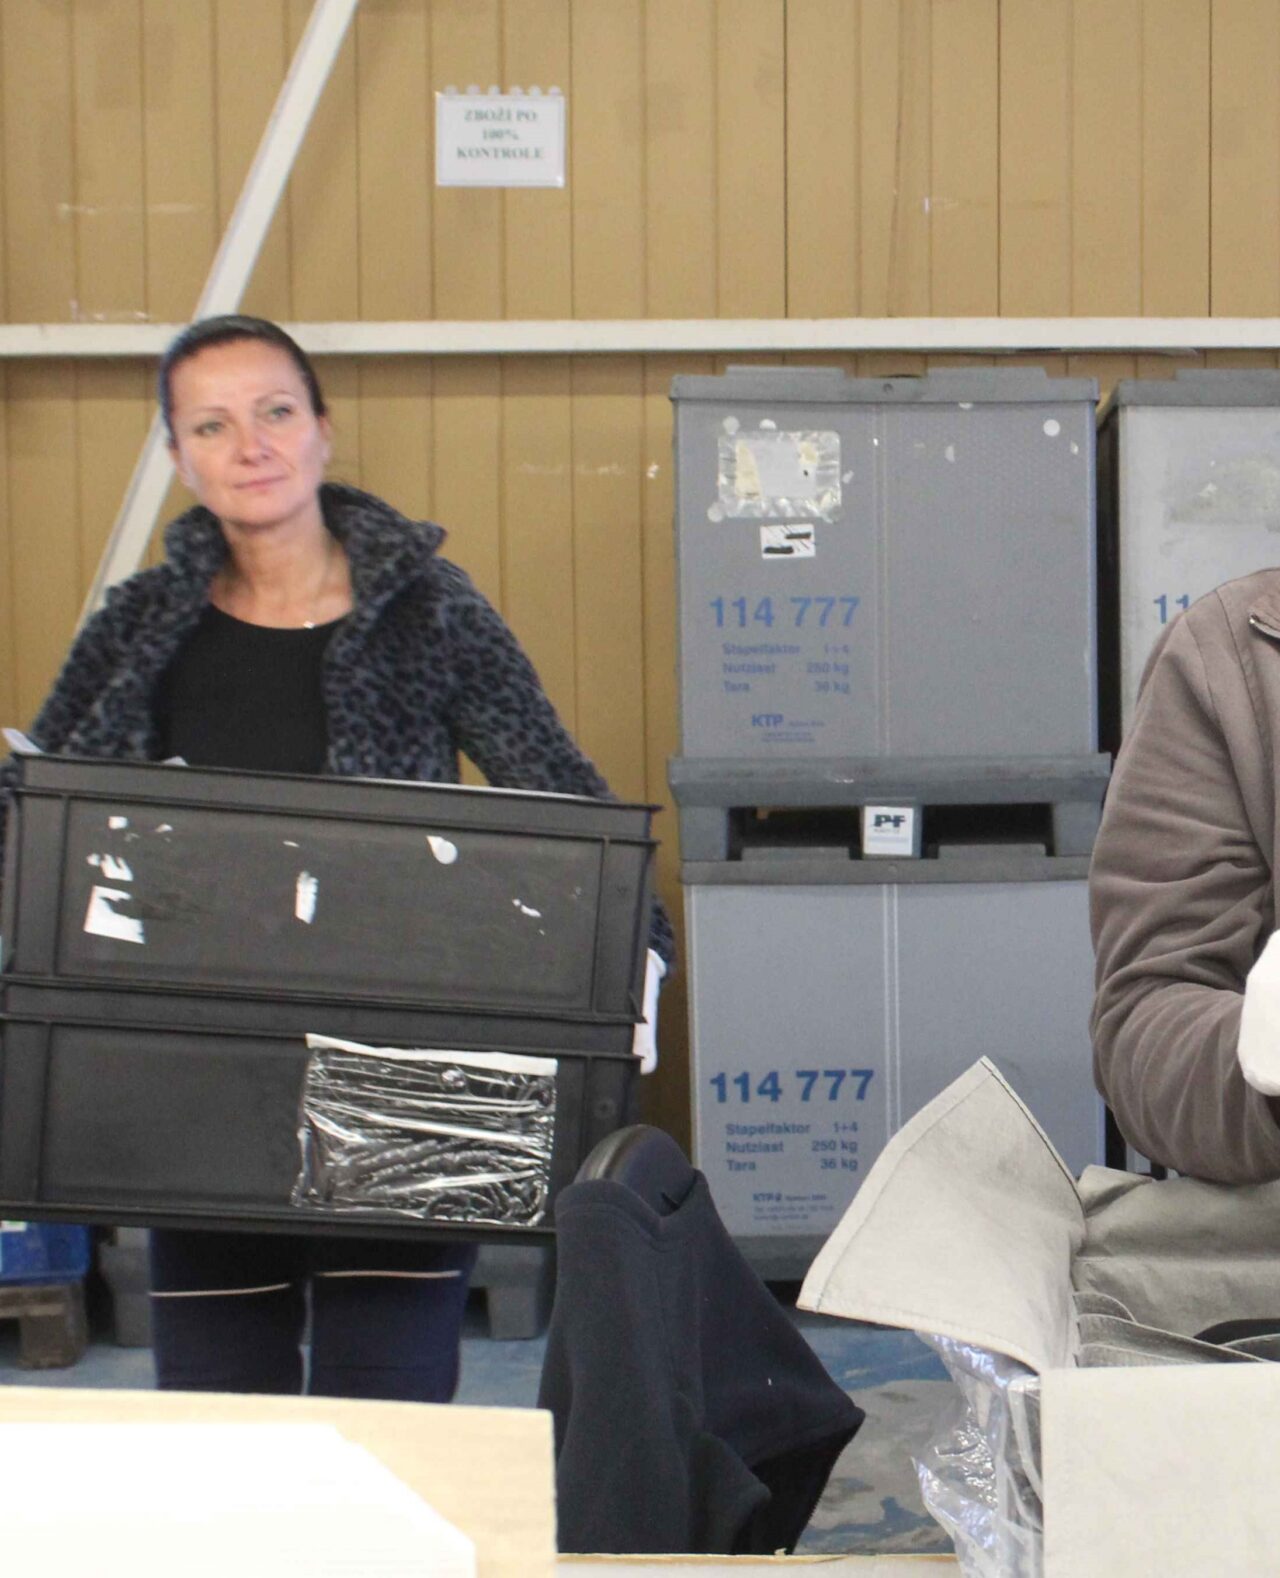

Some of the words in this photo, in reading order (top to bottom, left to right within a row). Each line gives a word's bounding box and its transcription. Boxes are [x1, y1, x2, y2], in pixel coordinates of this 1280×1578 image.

[515, 108, 537, 121] PO
[482, 128, 520, 141] 100%
[456, 147, 544, 159] KONTROLE
[709, 596, 775, 627] 114
[790, 596, 860, 627] 777
[833, 662, 849, 676] kg
[724, 680, 750, 692] Tara
[834, 681, 850, 695] kg
[752, 713, 784, 726] KTP
[709, 1071, 783, 1103] 114
[795, 1069, 874, 1101] 777
[725, 1123, 810, 1138] Stapelfaktor
[726, 1141, 784, 1153] Nutzlast
[812, 1140, 836, 1152] 250
[841, 1140, 858, 1154] kg
[727, 1159, 756, 1171] Tara
[820, 1158, 836, 1170] 36
[841, 1158, 858, 1171] kg
